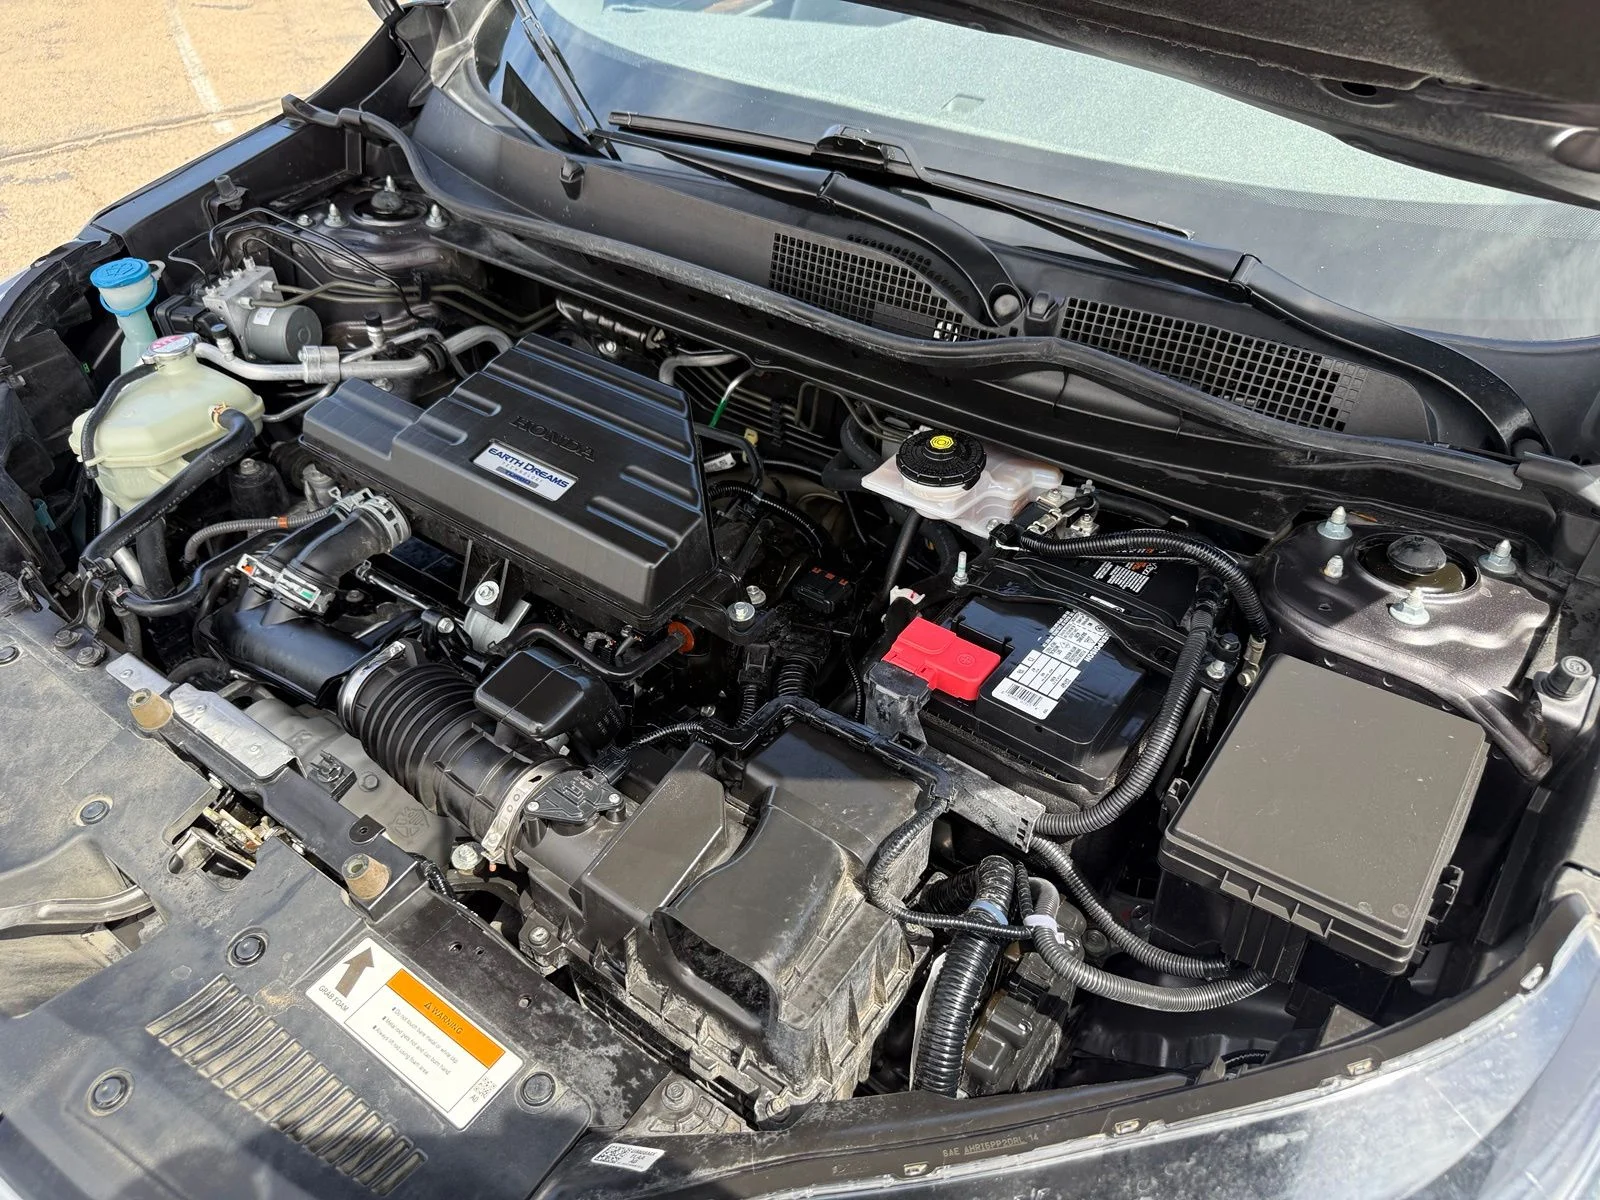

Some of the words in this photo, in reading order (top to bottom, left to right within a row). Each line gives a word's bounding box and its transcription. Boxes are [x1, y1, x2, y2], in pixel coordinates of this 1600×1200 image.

[509, 416, 595, 462] HONDA
[488, 447, 524, 468] EARTH
[523, 462, 570, 489] DREAMS
[318, 985, 335, 1000] GRAB
[332, 996, 350, 1012] FOAM
[431, 1006, 464, 1034] WARNING
[942, 1147, 961, 1157] SAE
